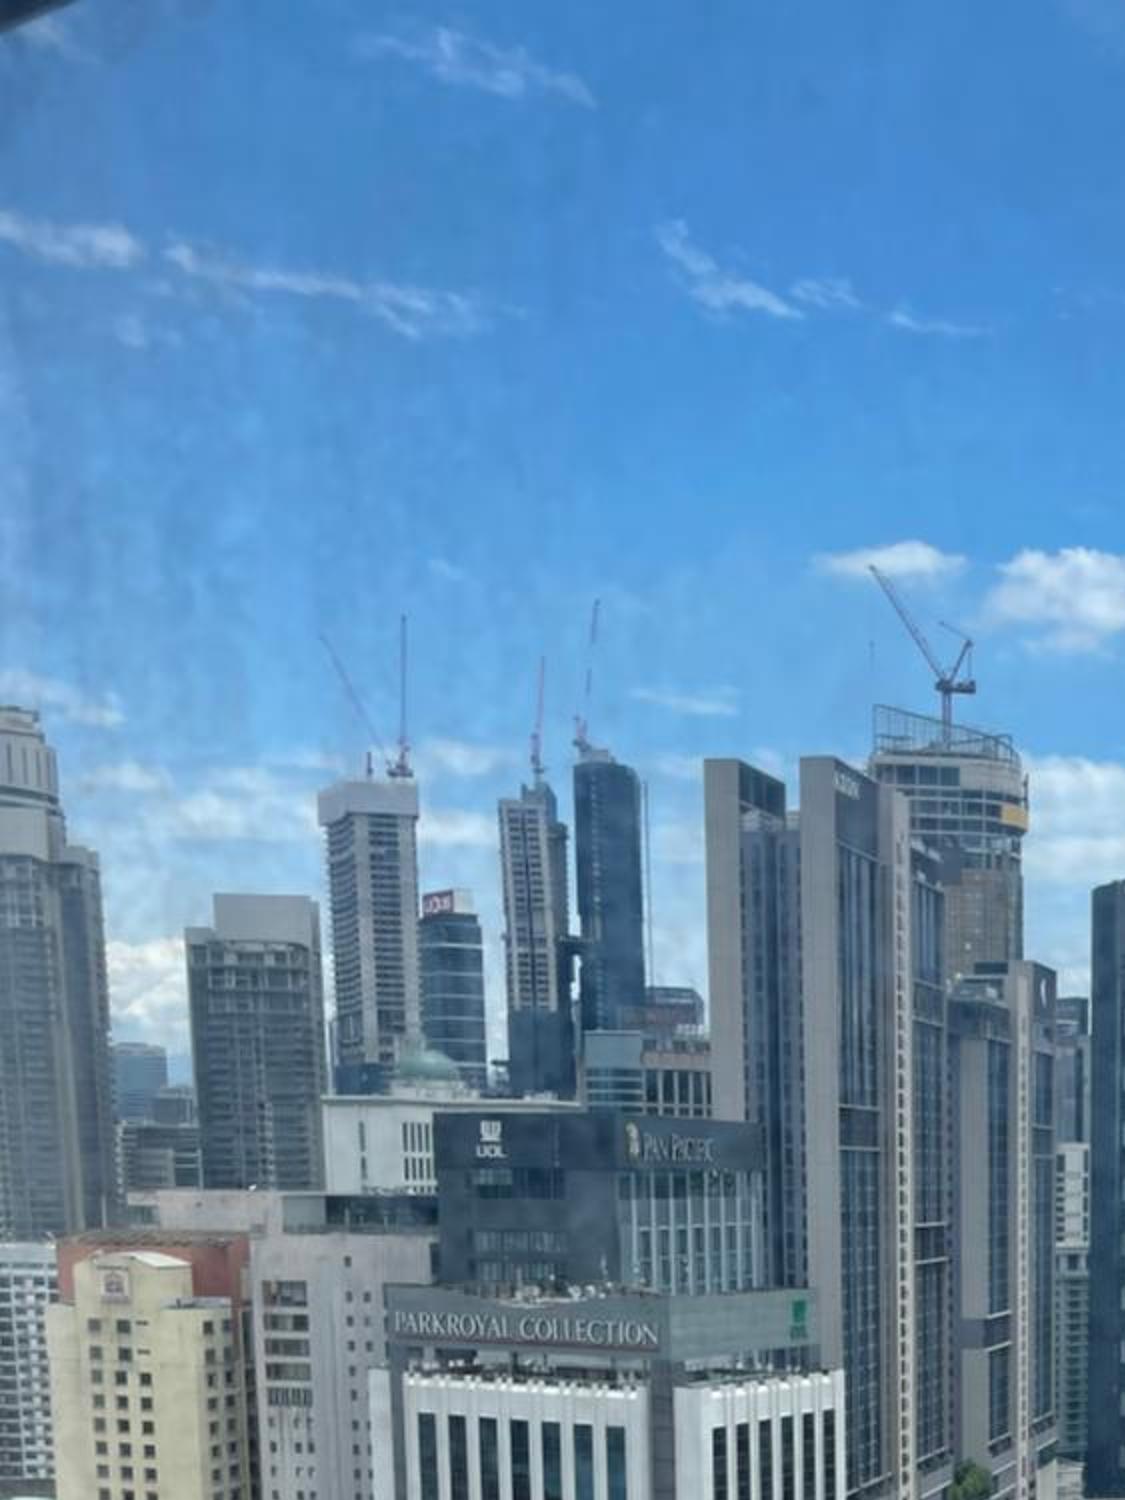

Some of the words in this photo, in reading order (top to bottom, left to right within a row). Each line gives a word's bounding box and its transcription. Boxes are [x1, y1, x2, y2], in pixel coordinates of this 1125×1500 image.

[476, 1144, 508, 1158] UOL
[394, 1311, 509, 1338] PARKROYAL
[520, 1317, 658, 1344] COLLECTION
